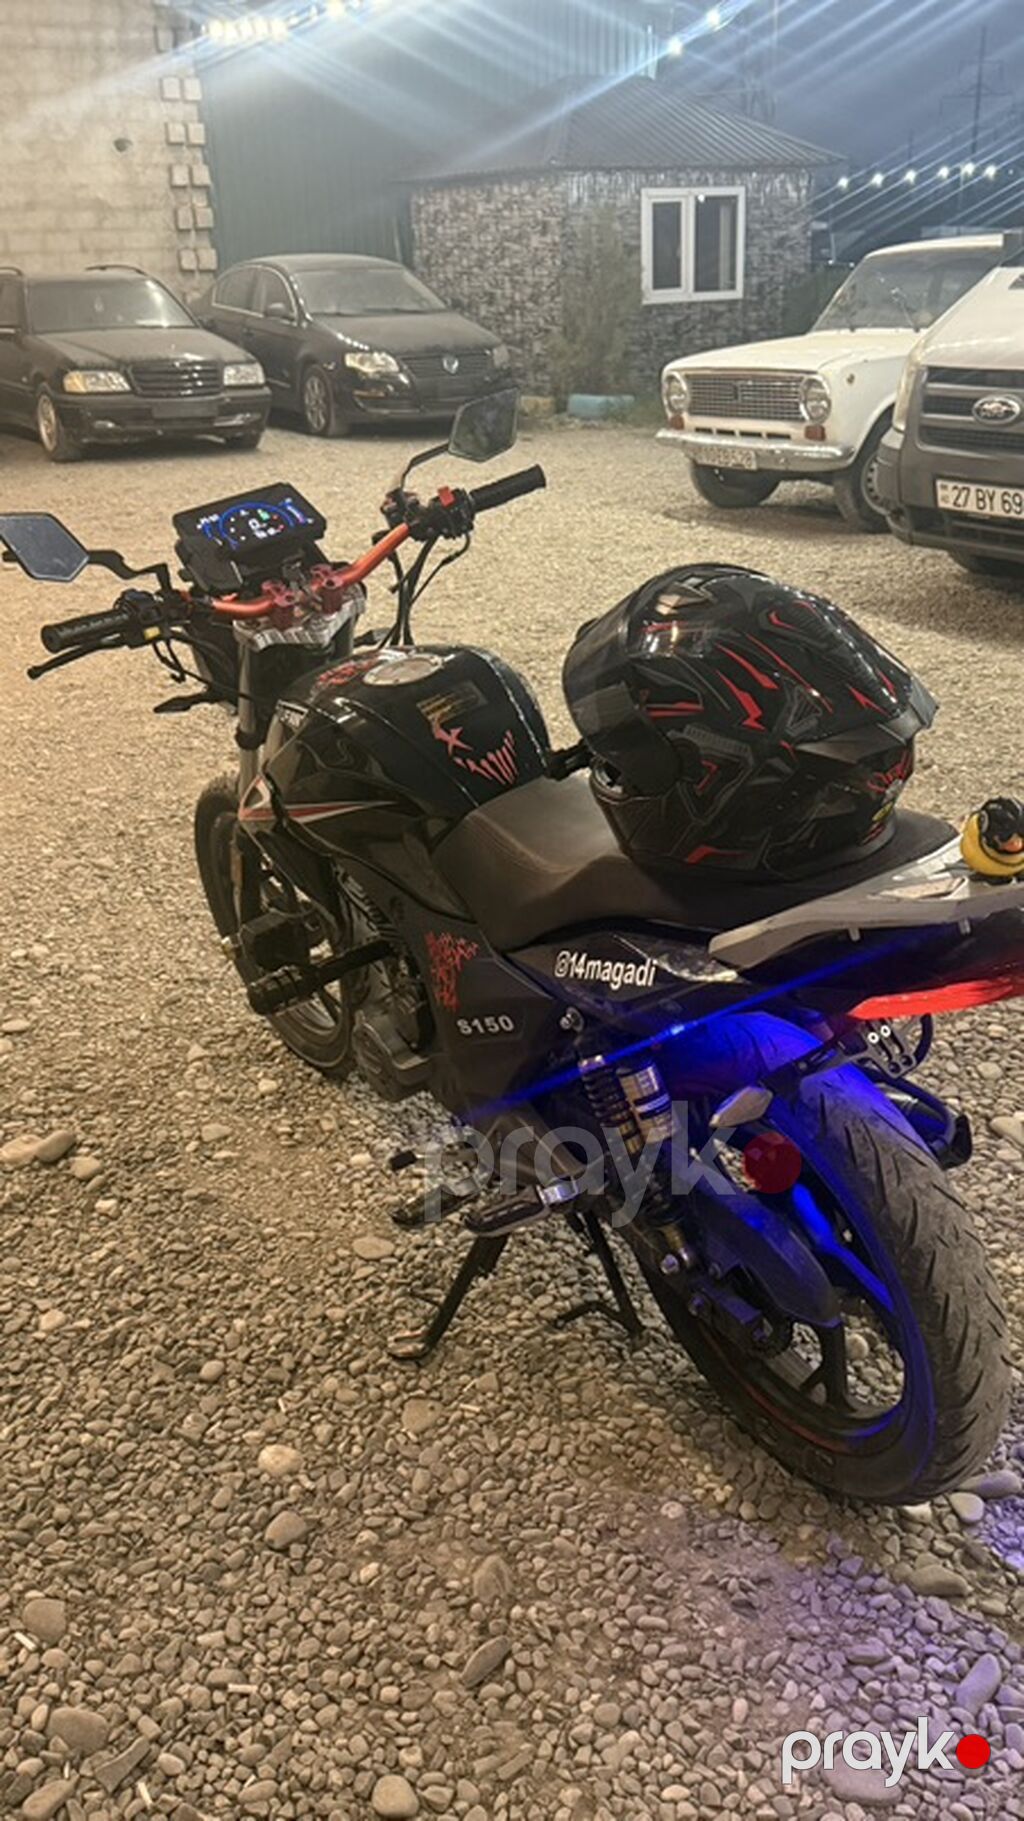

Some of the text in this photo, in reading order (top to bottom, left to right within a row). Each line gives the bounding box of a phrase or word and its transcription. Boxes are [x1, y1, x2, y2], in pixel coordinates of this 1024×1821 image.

[951, 485, 970, 508] 27
[975, 487, 996, 511] BY
[555, 950, 657, 990] @14magadi
[456, 1014, 515, 1036] S150
